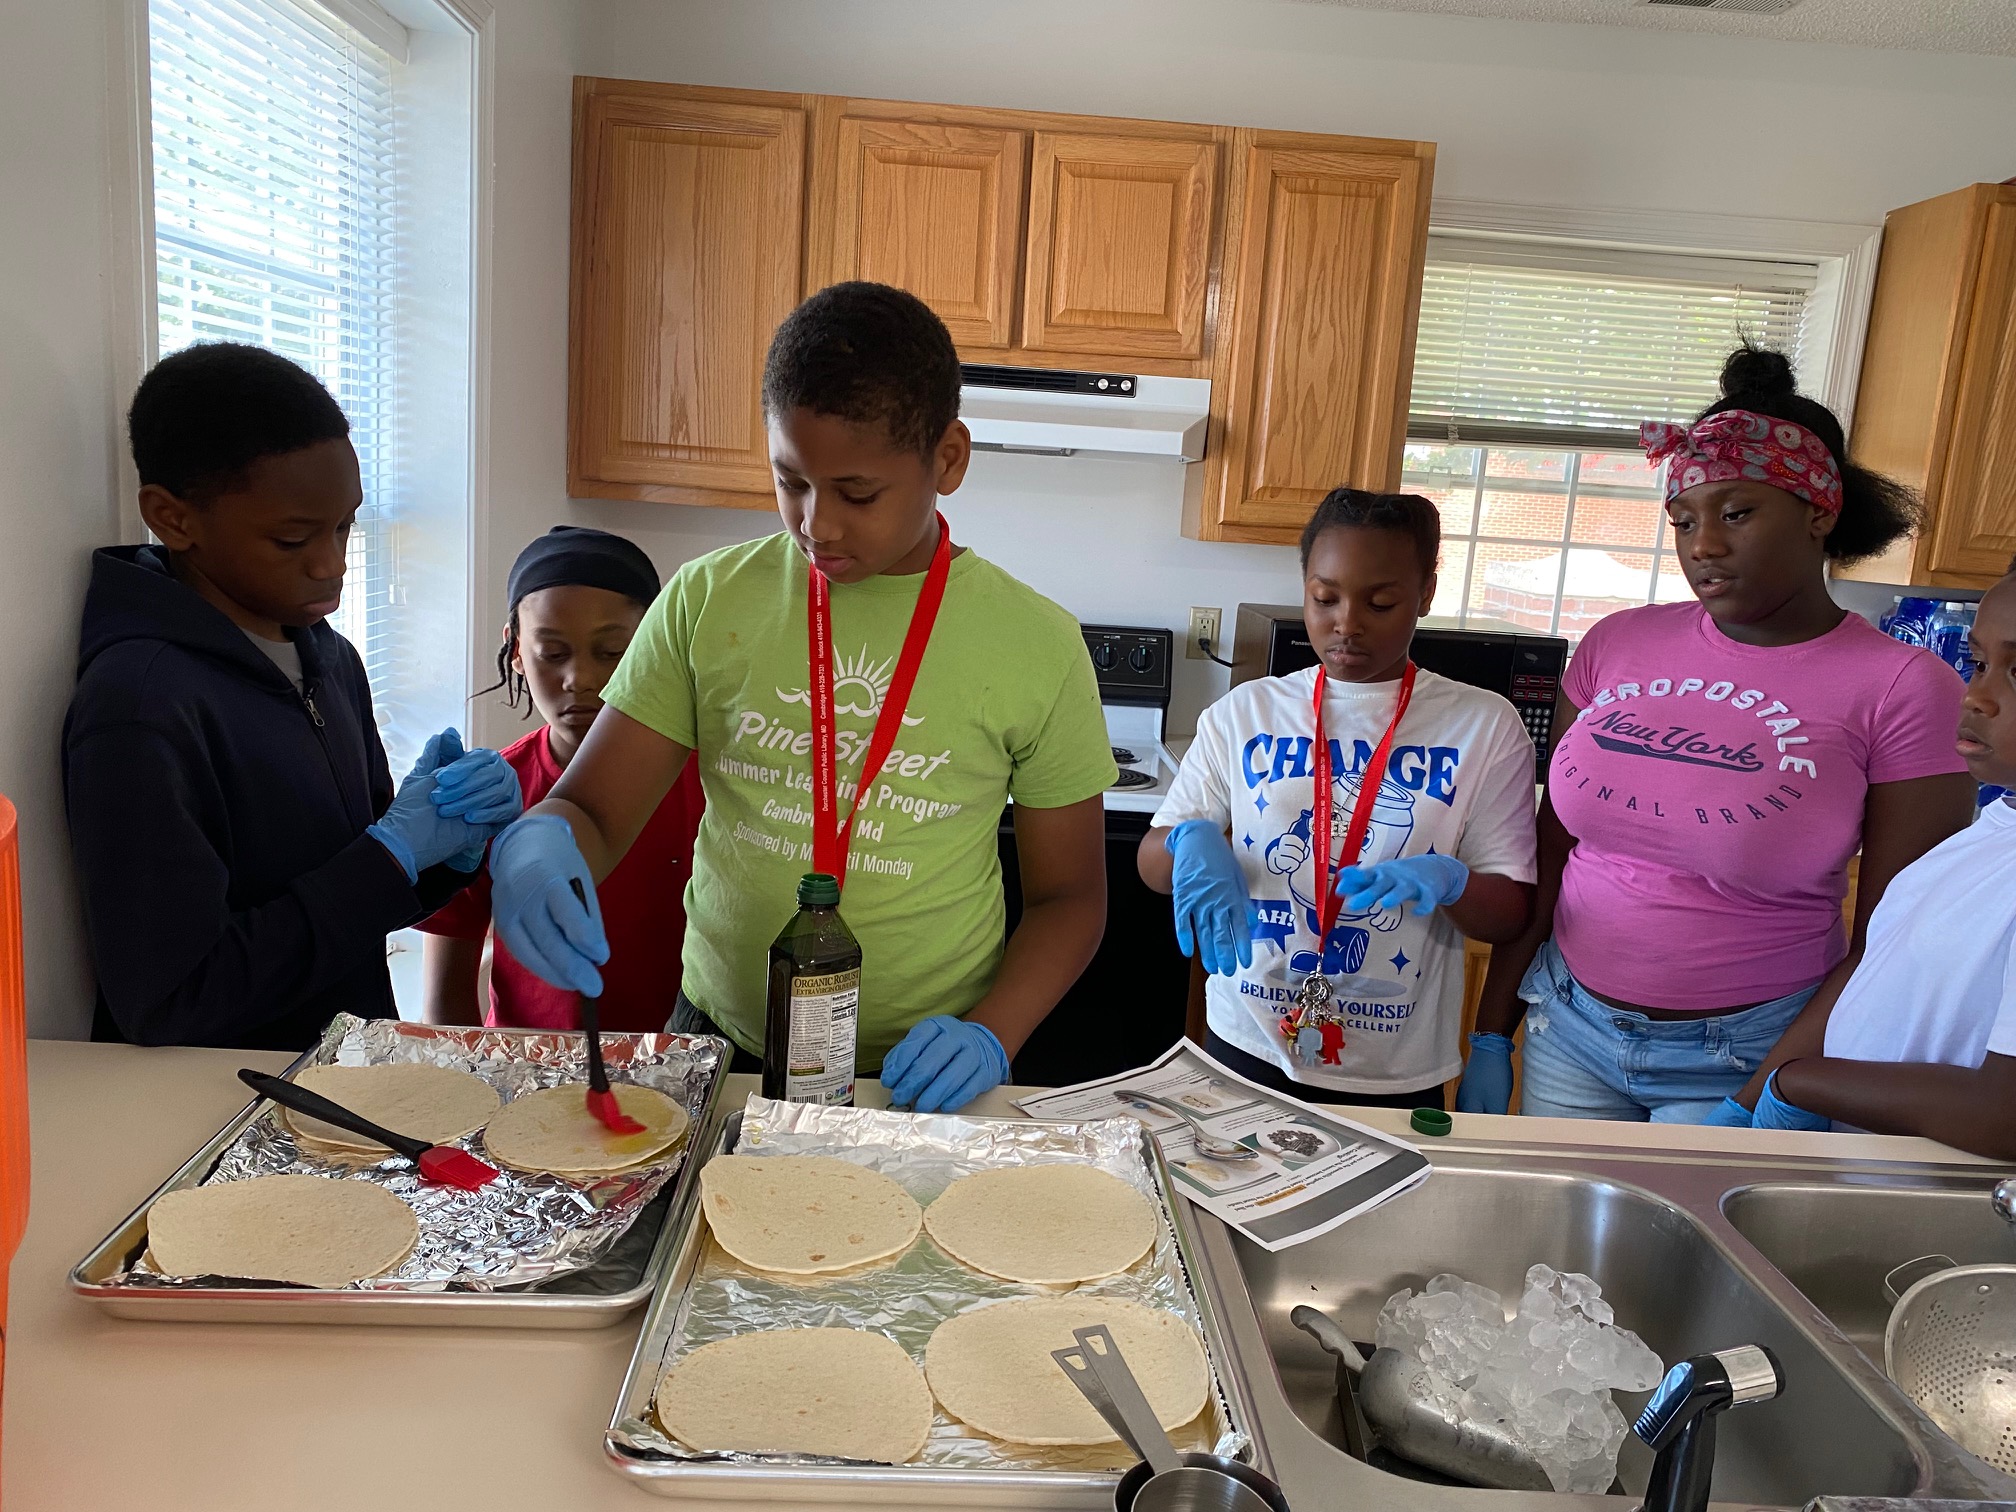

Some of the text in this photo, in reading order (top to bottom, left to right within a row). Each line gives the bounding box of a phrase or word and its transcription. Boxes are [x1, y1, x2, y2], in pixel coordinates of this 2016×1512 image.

[820, 694, 828, 720] Cambridge
[820, 724, 827, 734] MD
[1587, 710, 1659, 742] New
[1643, 726, 1764, 771] York
[734, 711, 951, 781] Pine Steet
[821, 767, 829, 785] County
[1558, 732, 1802, 824] ORIGINAL BRAND
[715, 754, 962, 823] ummer Leaing Program
[856, 820, 884, 842] Md
[733, 820, 781, 853] Sponsored
[782, 836, 798, 861] by
[863, 854, 913, 880] Monday
[1257, 908, 1296, 927] AH!
[794, 971, 859, 988] ORGANIC ROBUST
[1240, 980, 1302, 1003] BELIEV
[1346, 1019, 1401, 1033] CELLENT
